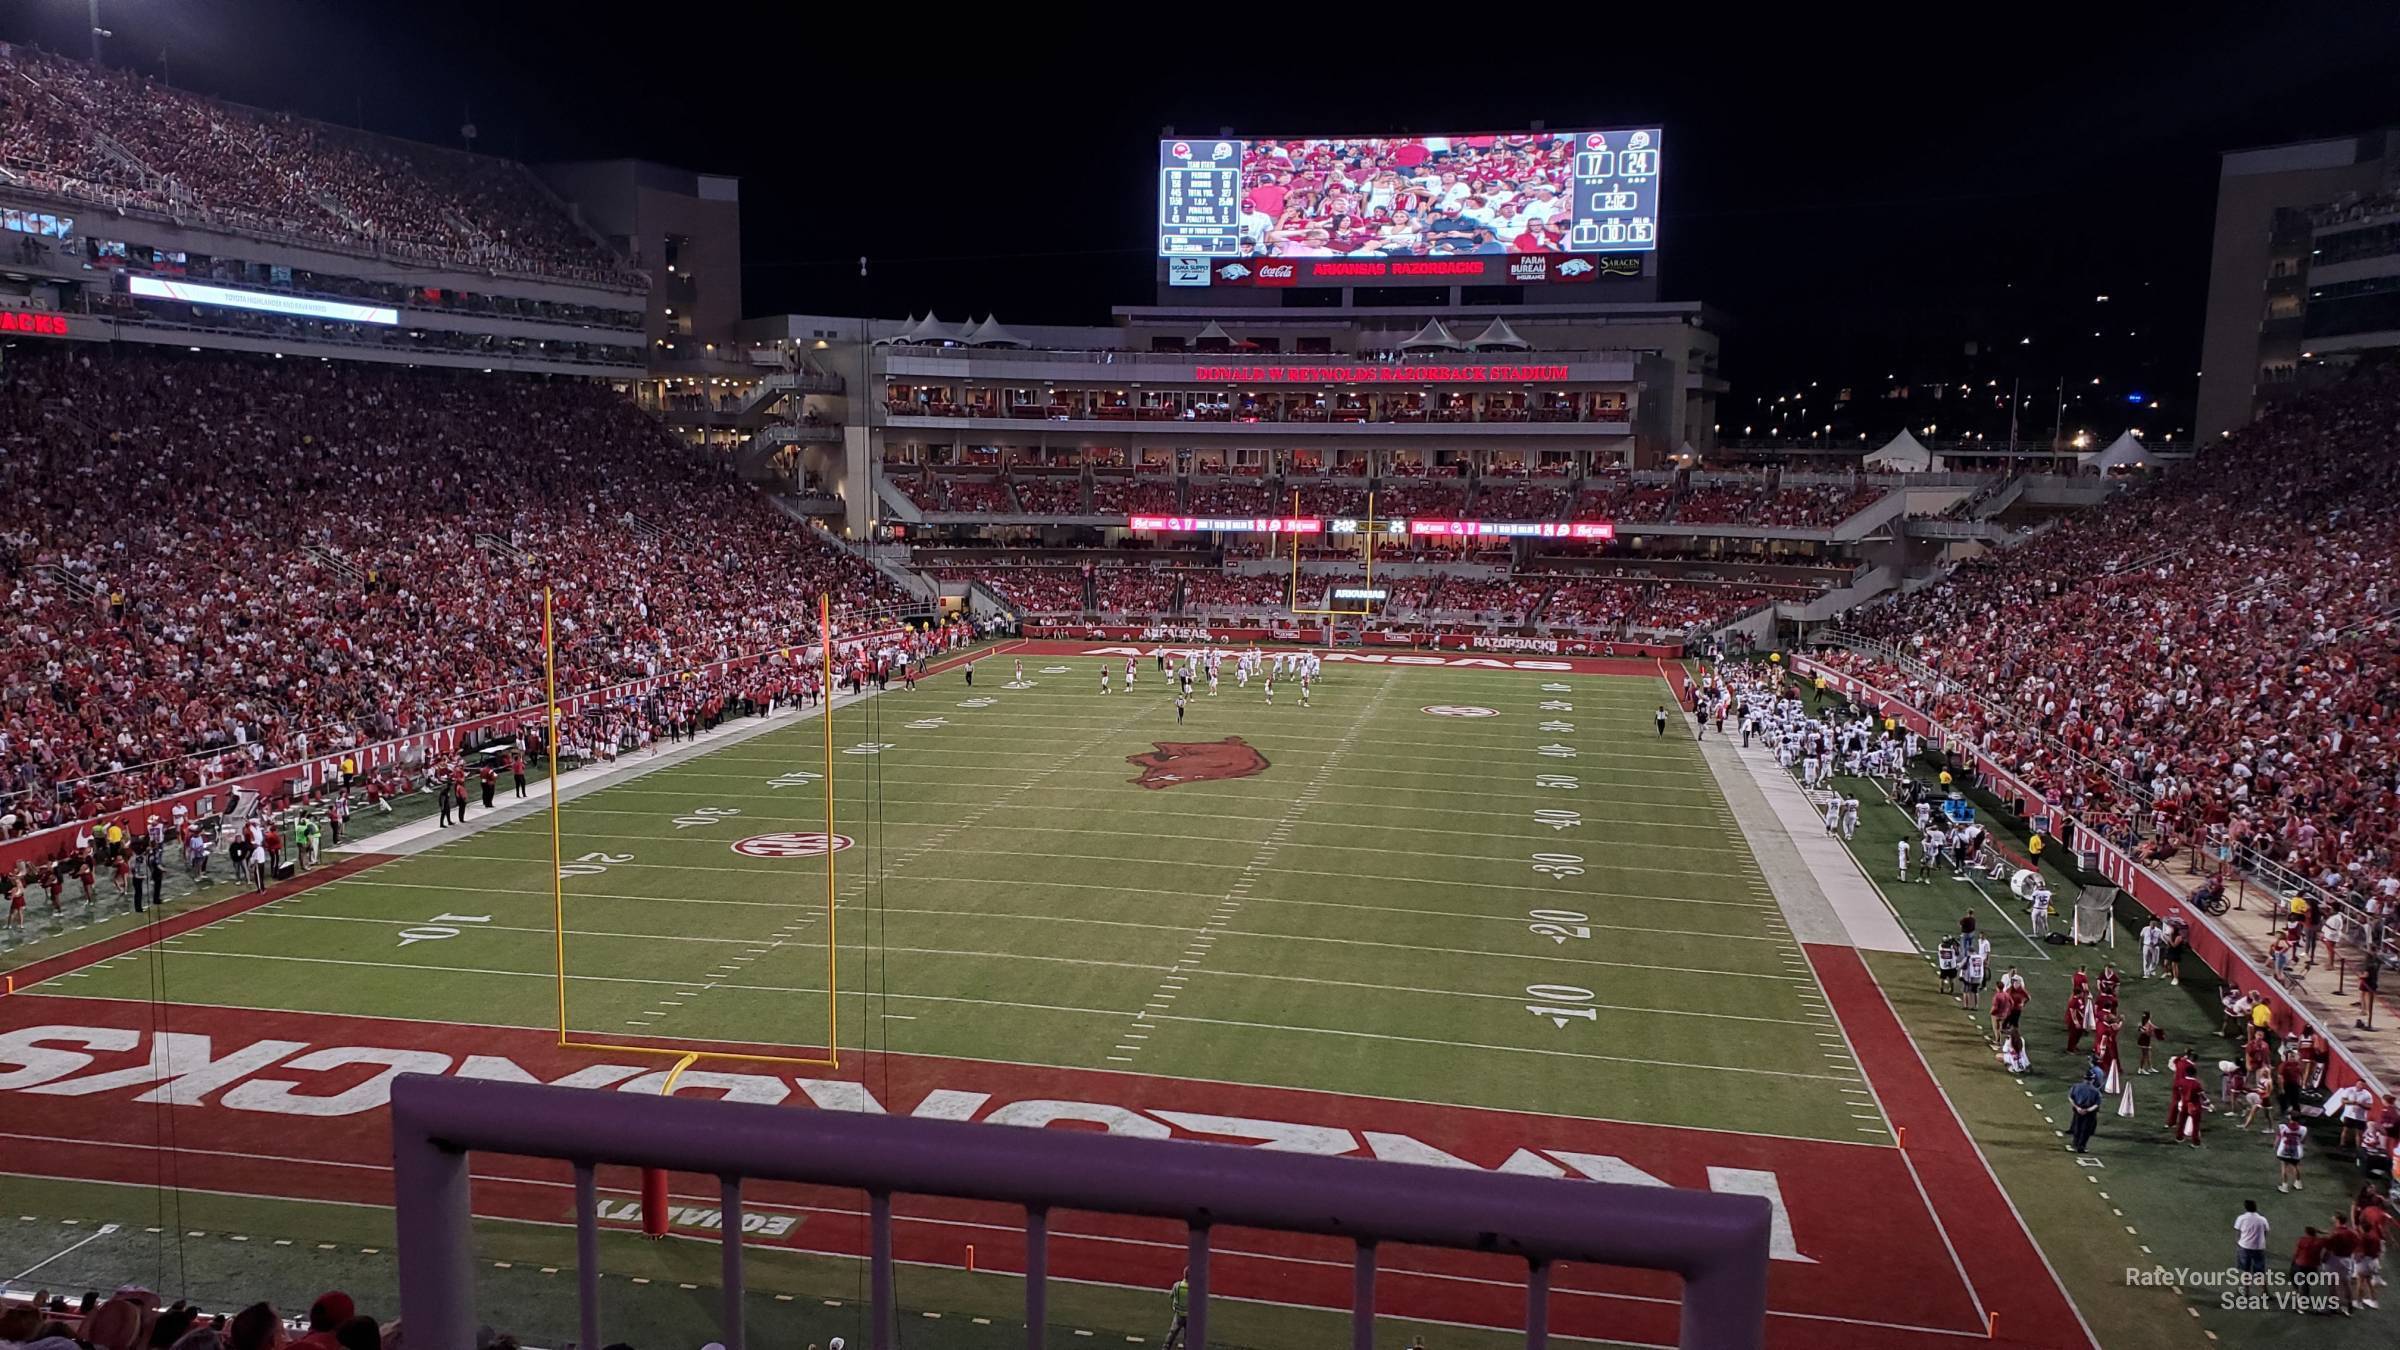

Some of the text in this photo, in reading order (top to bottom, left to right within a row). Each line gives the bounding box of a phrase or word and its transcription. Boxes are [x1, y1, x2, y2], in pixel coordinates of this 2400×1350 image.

[1588, 154, 1602, 175] 17
[1629, 153, 1647, 173] 24
[1605, 194, 1626, 209] 2:02
[1608, 226, 1618, 240] 10
[1635, 226, 1646, 240] 15
[1521, 256, 1545, 264] FARM
[1600, 257, 1640, 269] SARACEN
[1312, 261, 1484, 276] ARKANSAS RAZORBACKS
[1511, 264, 1546, 273] BUREAU
[224, 293, 247, 303] TOYOTA
[1196, 365, 1568, 381] DONALD W REYNOLDS RAZORBACK STADIUM
[1332, 520, 1357, 532] 2:02
[1390, 521, 1406, 533] 25
[1334, 589, 1387, 599] ARKANSAS
[1537, 745, 1577, 758] 40
[302, 728, 456, 791] UNVERITY
[766, 771, 825, 786] 40
[1536, 774, 1579, 789] 50
[671, 807, 742, 825] 30
[1533, 809, 1582, 827] 40
[559, 852, 635, 875] 20
[1532, 853, 1585, 875] 30
[2070, 825, 2135, 897] RKANSAS
[398, 912, 492, 940] 10
[1529, 909, 1591, 939] 20
[1525, 984, 1597, 1021] 10
[597, 1199, 797, 1236] EQUATY
